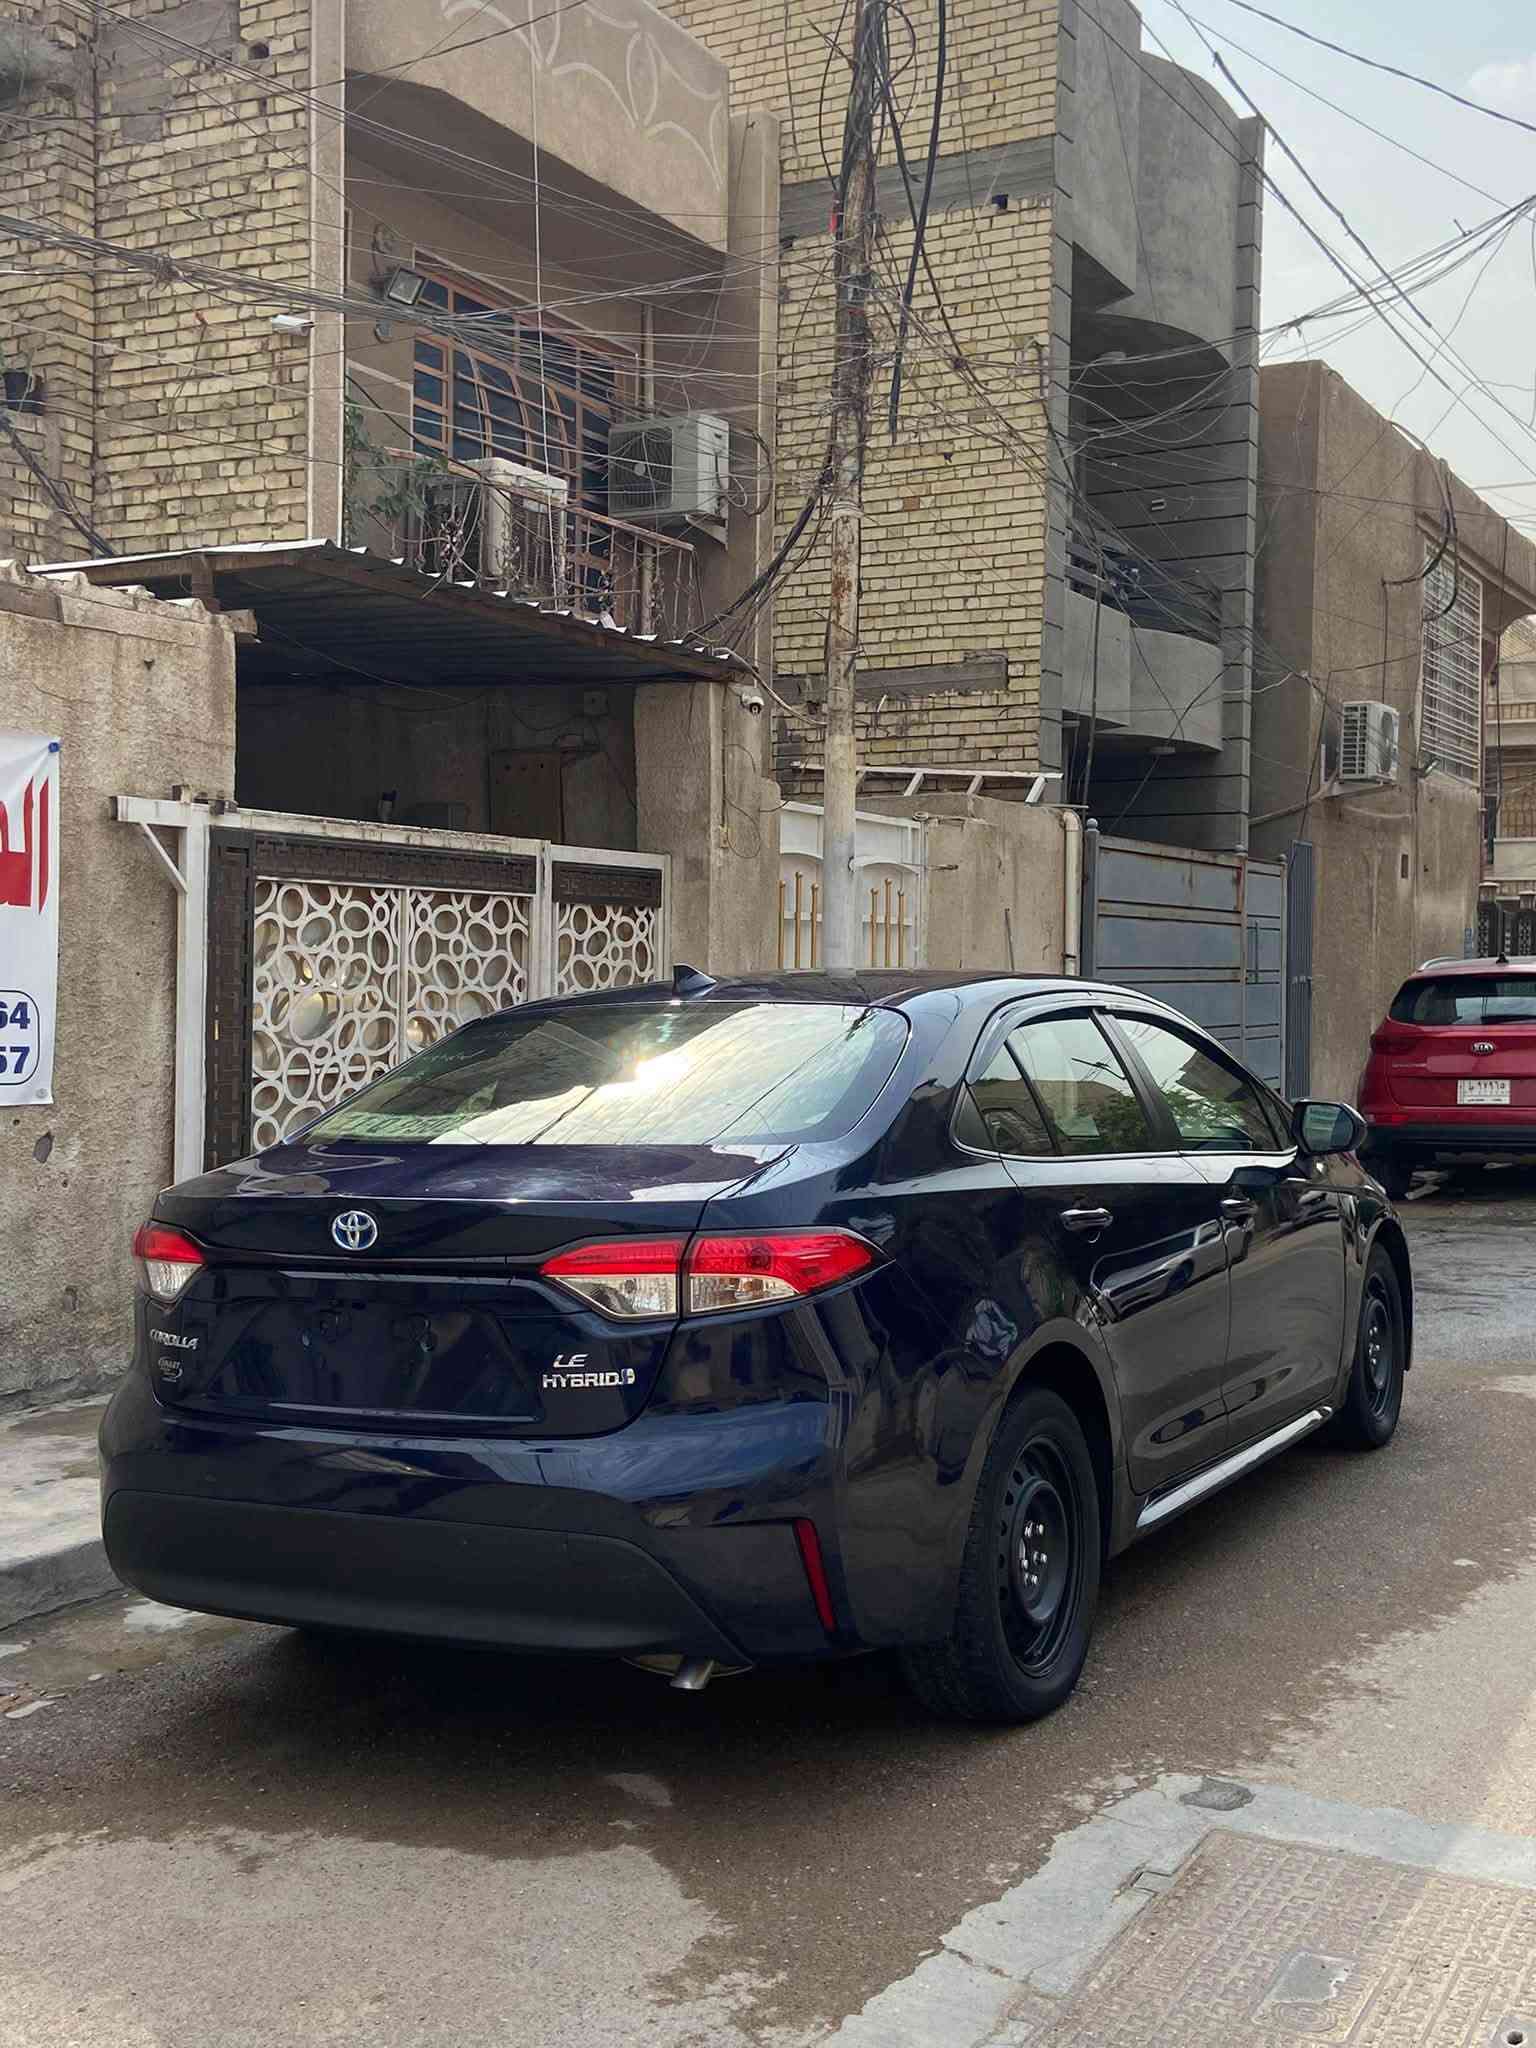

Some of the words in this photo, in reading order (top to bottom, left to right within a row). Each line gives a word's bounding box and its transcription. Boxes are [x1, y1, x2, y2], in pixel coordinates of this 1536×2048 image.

[149, 1328, 199, 1350] COROLLA
[553, 1353, 588, 1368] LE
[542, 1371, 620, 1388] HYBRID
